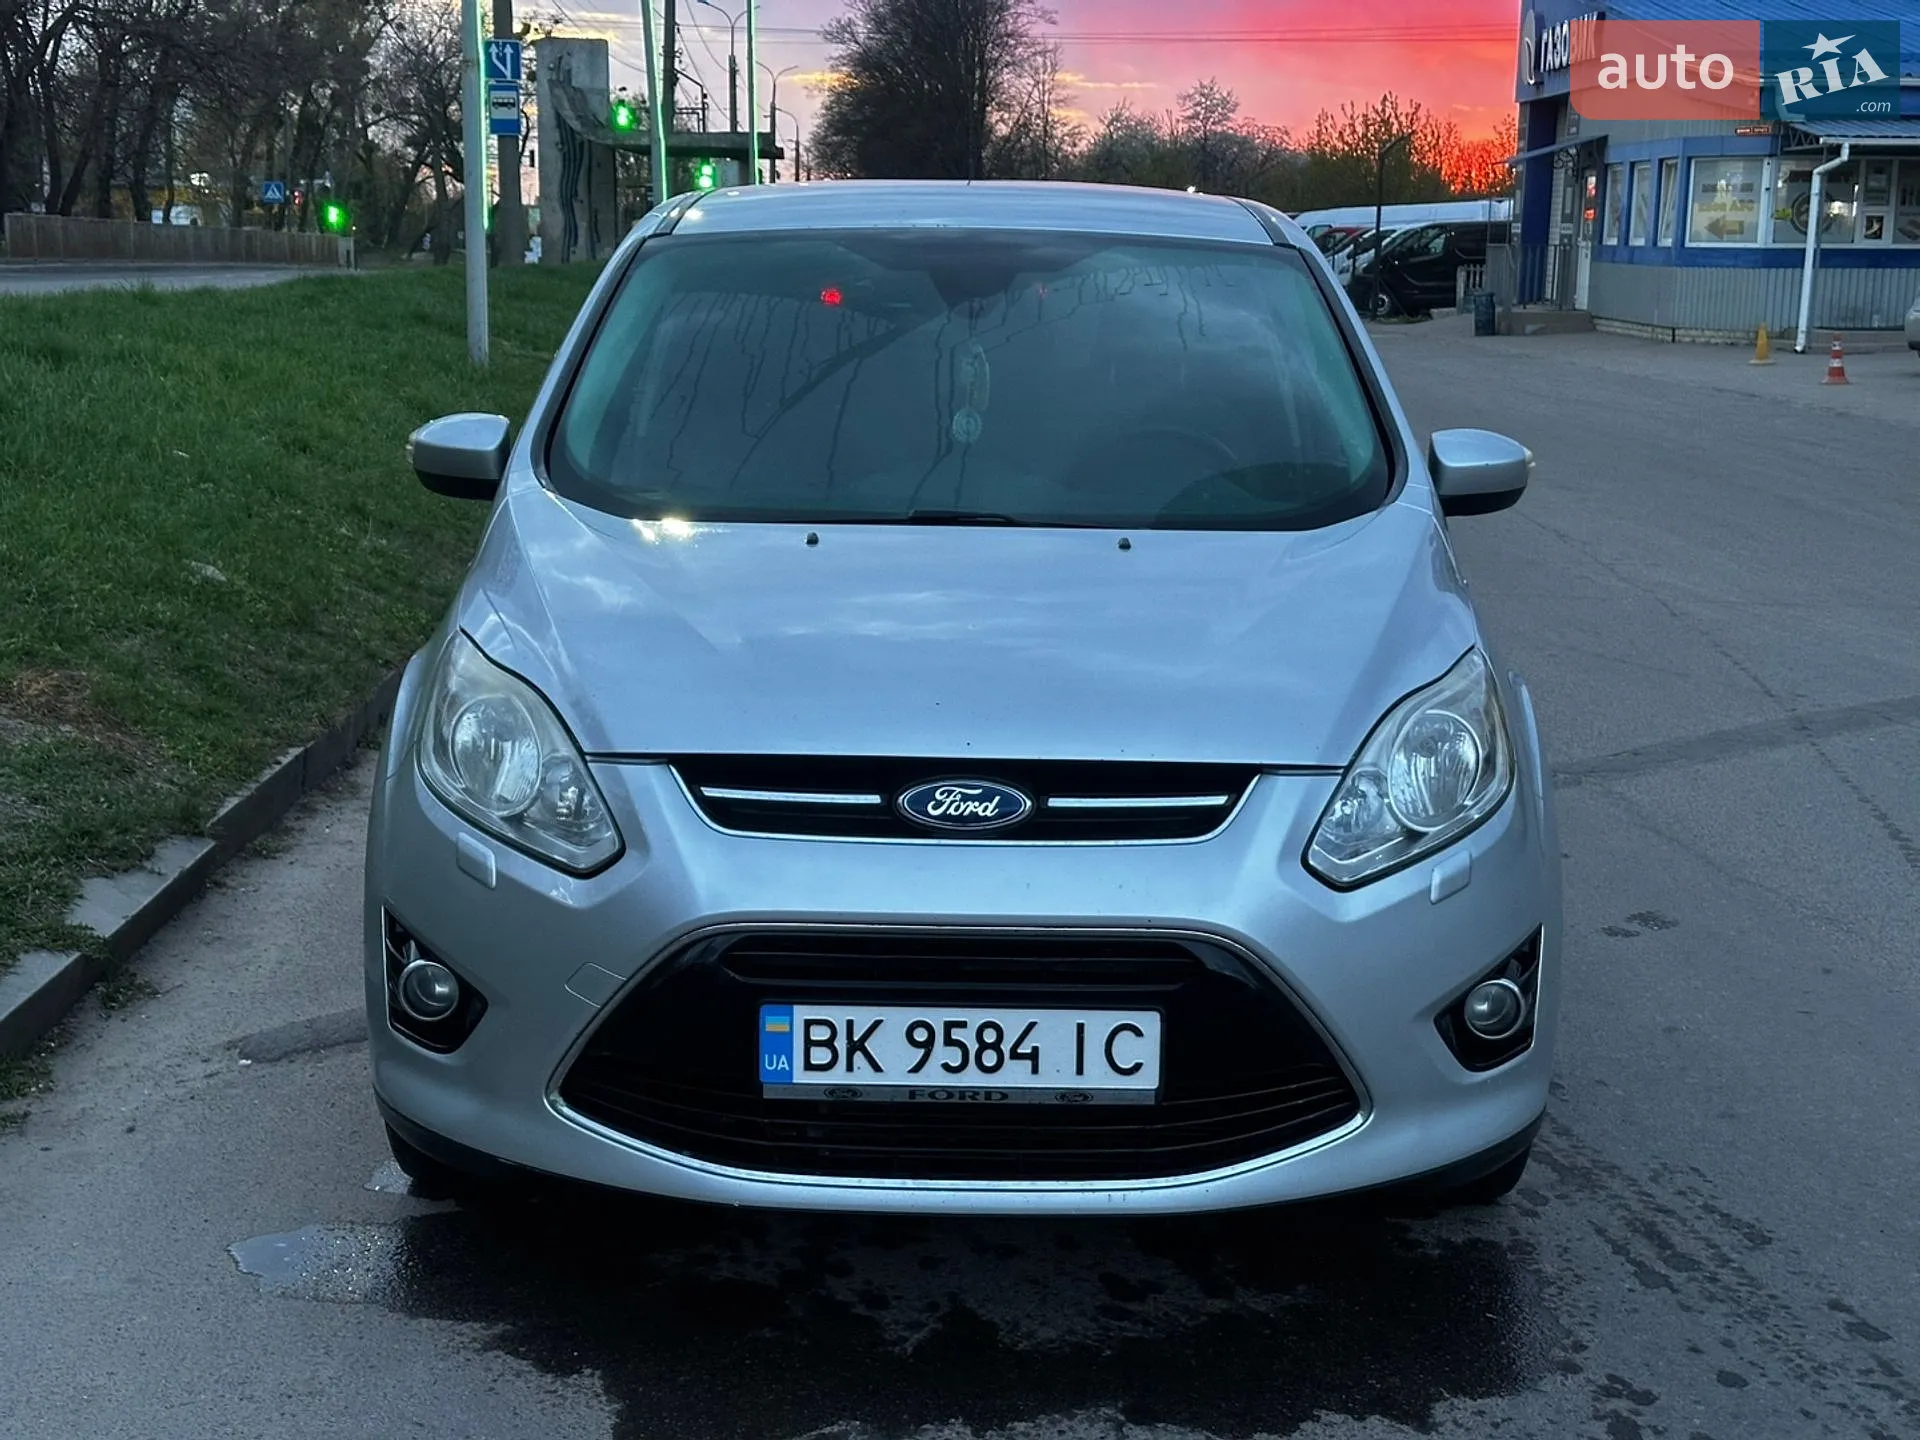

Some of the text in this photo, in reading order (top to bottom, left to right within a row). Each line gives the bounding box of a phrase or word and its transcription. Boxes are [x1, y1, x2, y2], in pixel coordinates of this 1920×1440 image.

[1540, 11, 1598, 72] ГАЗОВИК
[927, 786, 1001, 817] Ford
[765, 1054, 790, 1071] UA
[803, 1018, 1145, 1076] BK 9584 IC
[908, 1089, 1009, 1101] FORD
